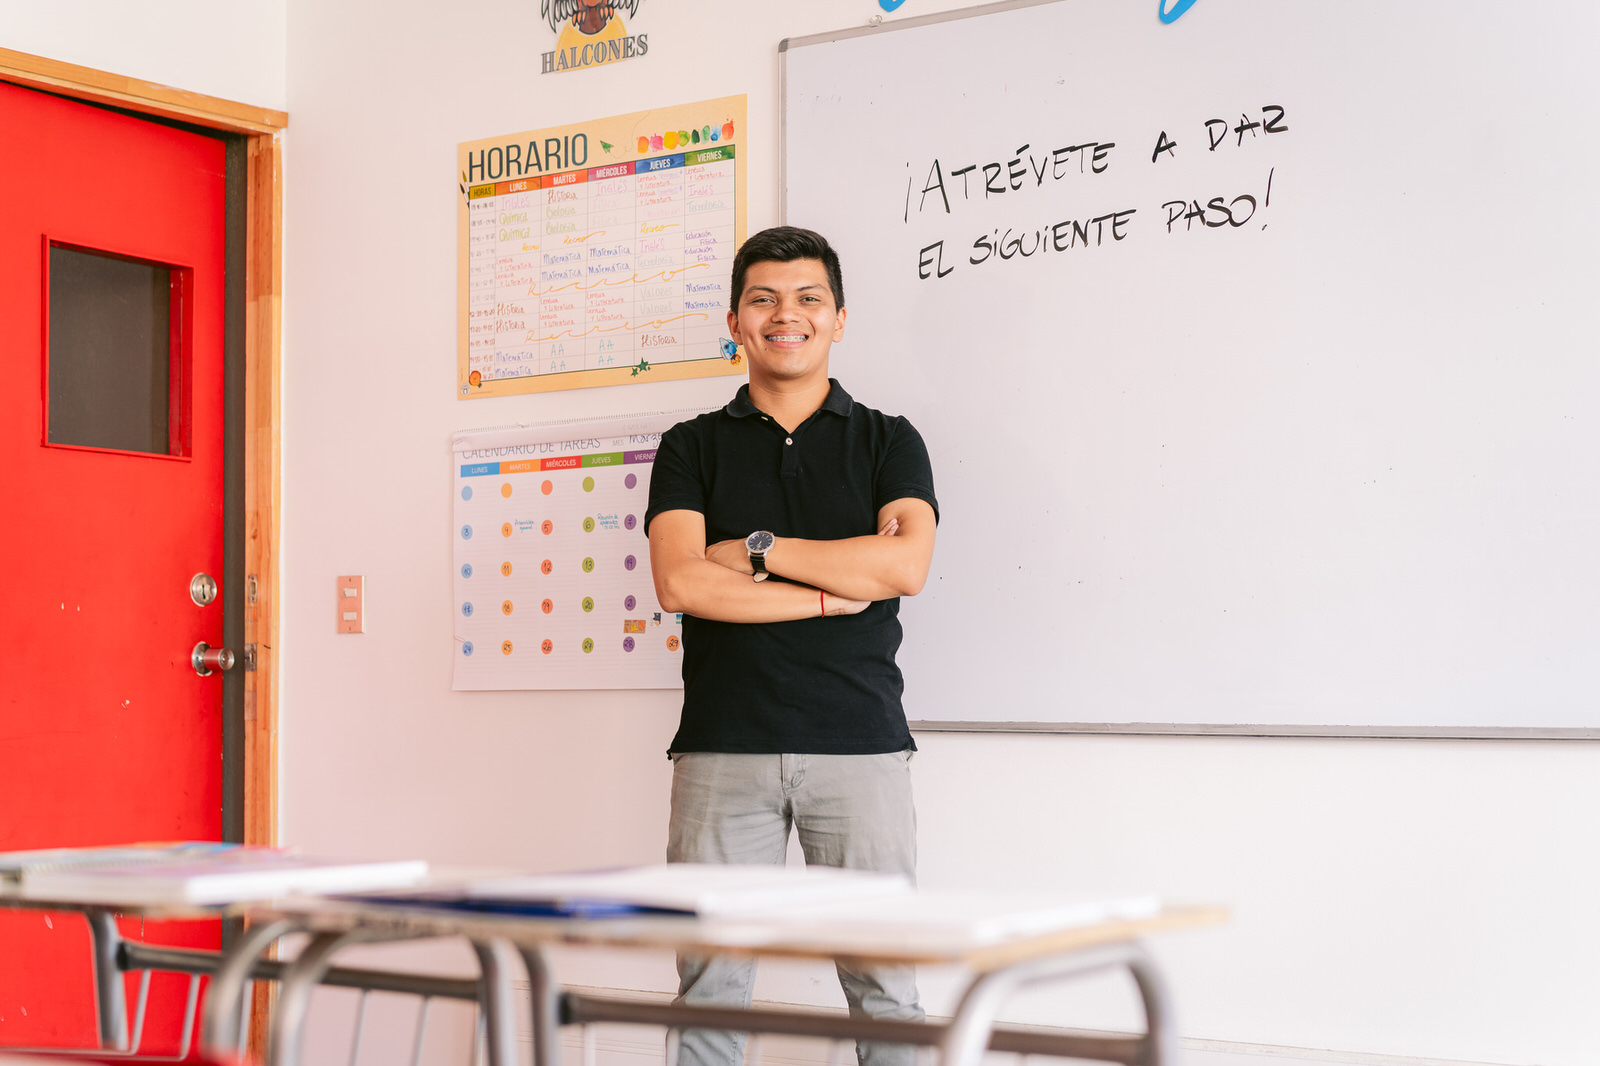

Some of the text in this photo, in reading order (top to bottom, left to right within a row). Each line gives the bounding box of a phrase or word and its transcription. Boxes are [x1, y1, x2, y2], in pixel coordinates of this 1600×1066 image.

[540, 33, 649, 74] HALCONES
[468, 133, 588, 183] HORARIO
[473, 150, 722, 197] HORAS LUNES MARTES MIÉRCOLES JUEVES VIERNES
[904, 104, 1289, 224] ¡ATRÉVETE A DAR
[918, 240, 955, 280] EL
[1162, 166, 1275, 235] PASO!
[471, 466, 488, 474] LUNES
[509, 463, 531, 471] MARTES
[546, 458, 577, 468] MIÉRCOLES
[591, 456, 612, 465] JUEVES
[543, 523, 550, 533] 5
[585, 520, 591, 530] 6
[543, 561, 552, 573] 12
[584, 560, 593, 571] 13
[543, 641, 552, 652] 26
[668, 638, 679, 648] 29
